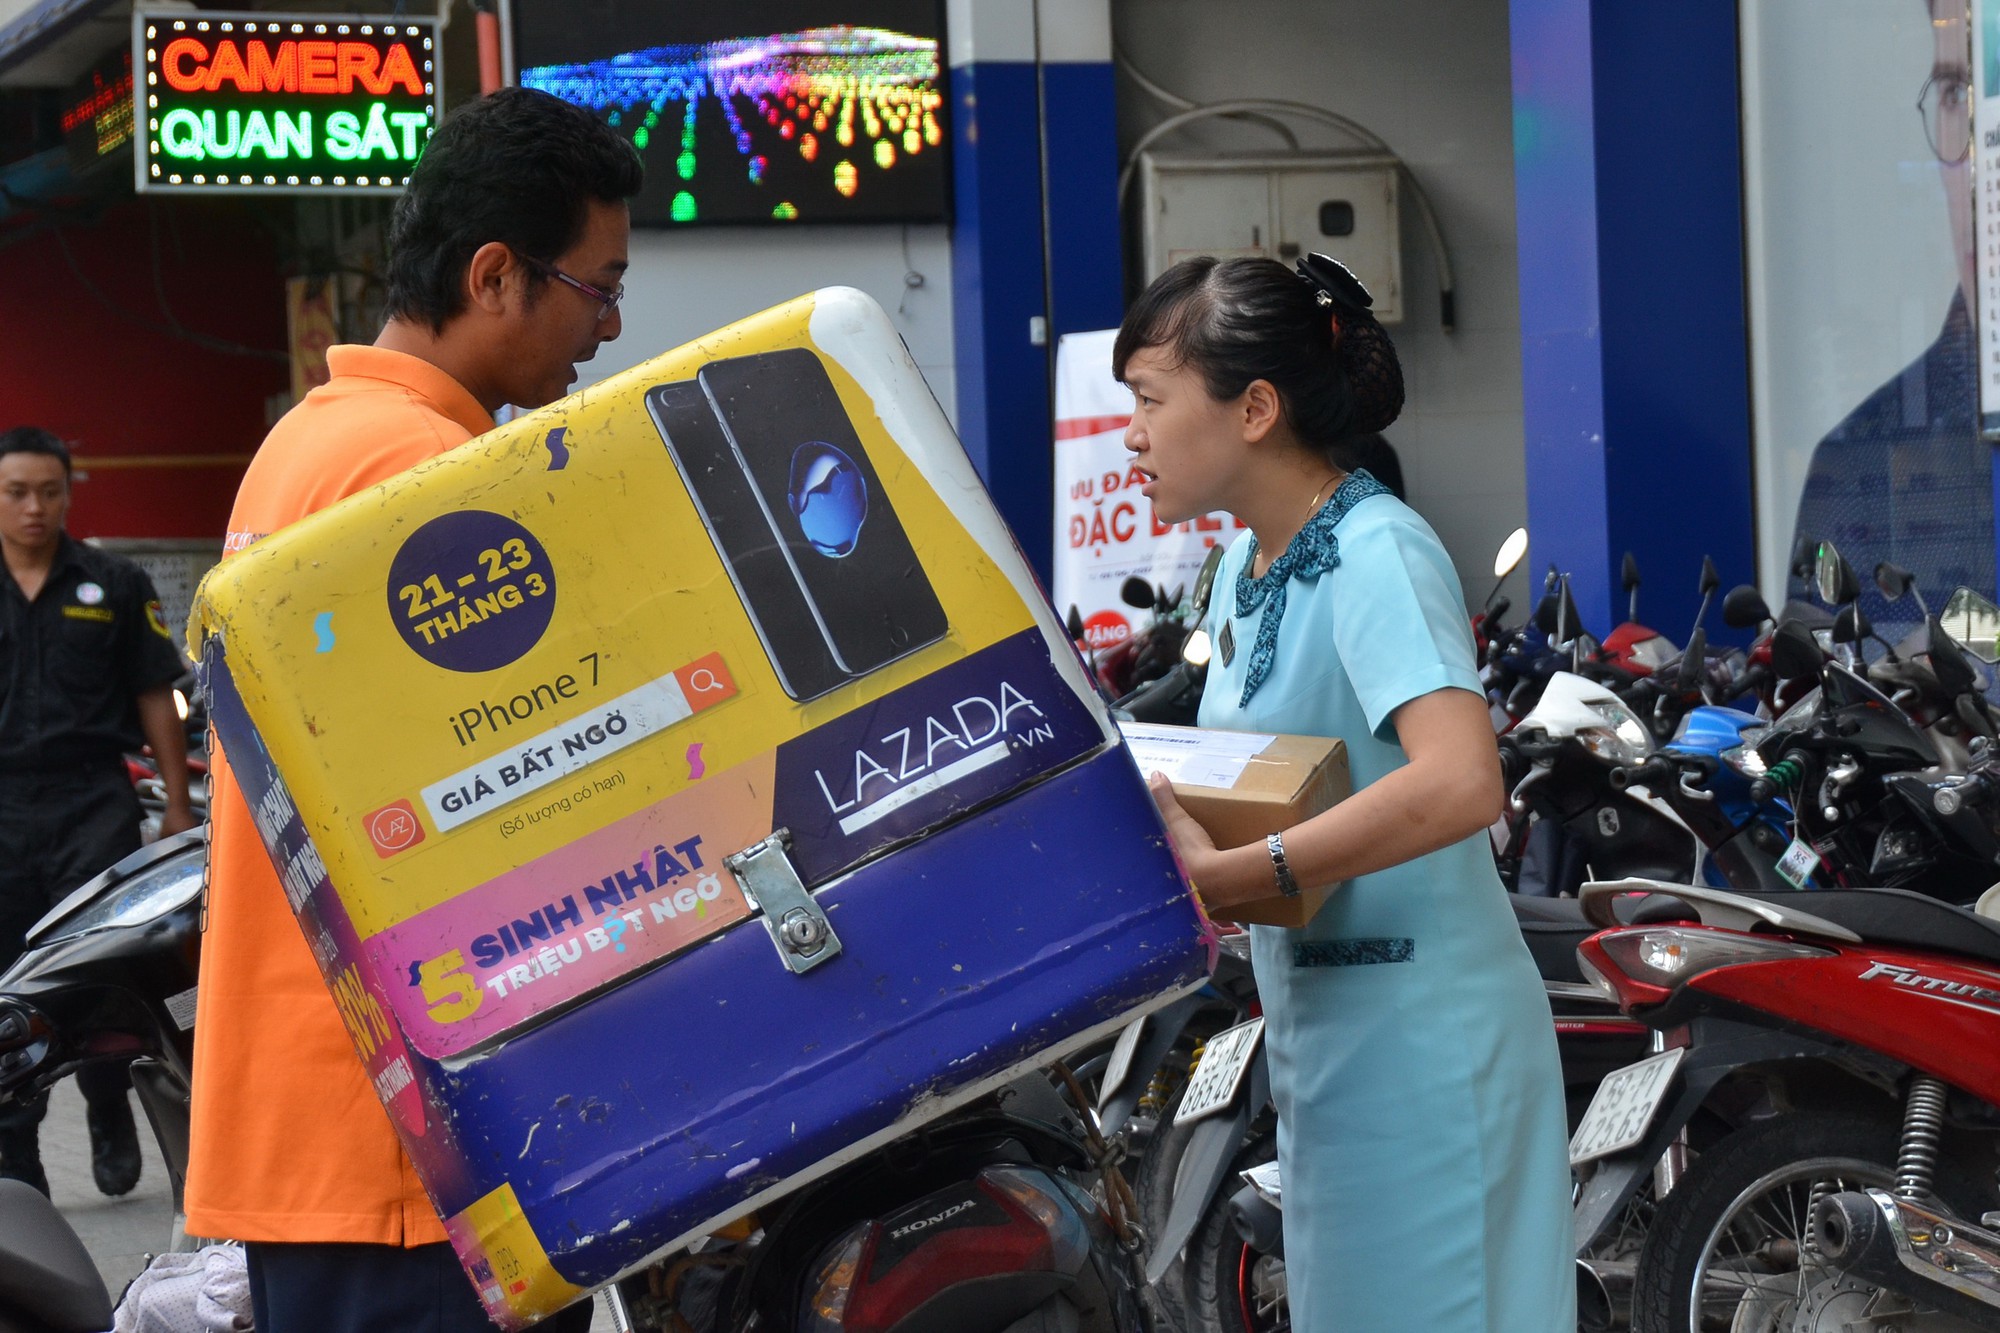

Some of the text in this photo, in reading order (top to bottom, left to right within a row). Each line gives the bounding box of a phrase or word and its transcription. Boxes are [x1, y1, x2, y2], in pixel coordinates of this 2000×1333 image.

[162, 38, 424, 95] CAMERA
[160, 108, 312, 161] QUAN
[324, 102, 428, 160] SÁT
[1102, 457, 1147, 494] ĐÃ
[1069, 497, 1136, 557] ĐẶC
[399, 573, 455, 618] 21
[478, 538, 532, 582] 23
[414, 573, 547, 645] THÁNG 3
[449, 652, 598, 746] iPhone 7
[440, 709, 627, 813] GIÁ BẤT NGỜ
[815, 681, 1044, 813] LAZADA
[378, 816, 409, 842] LAZ
[500, 770, 626, 838] (Số lượng có hạn)
[1793, 850, 1807, 864] 85
[470, 834, 705, 969] SINH NHẬT
[486, 938, 583, 999] TRIỆU
[649, 871, 722, 924] NGỜ
[419, 948, 483, 1024] 5
[1181, 1066, 1240, 1116] 865.48
[1571, 1101, 1652, 1157] 425.63
[890, 1200, 976, 1239] HONDA
